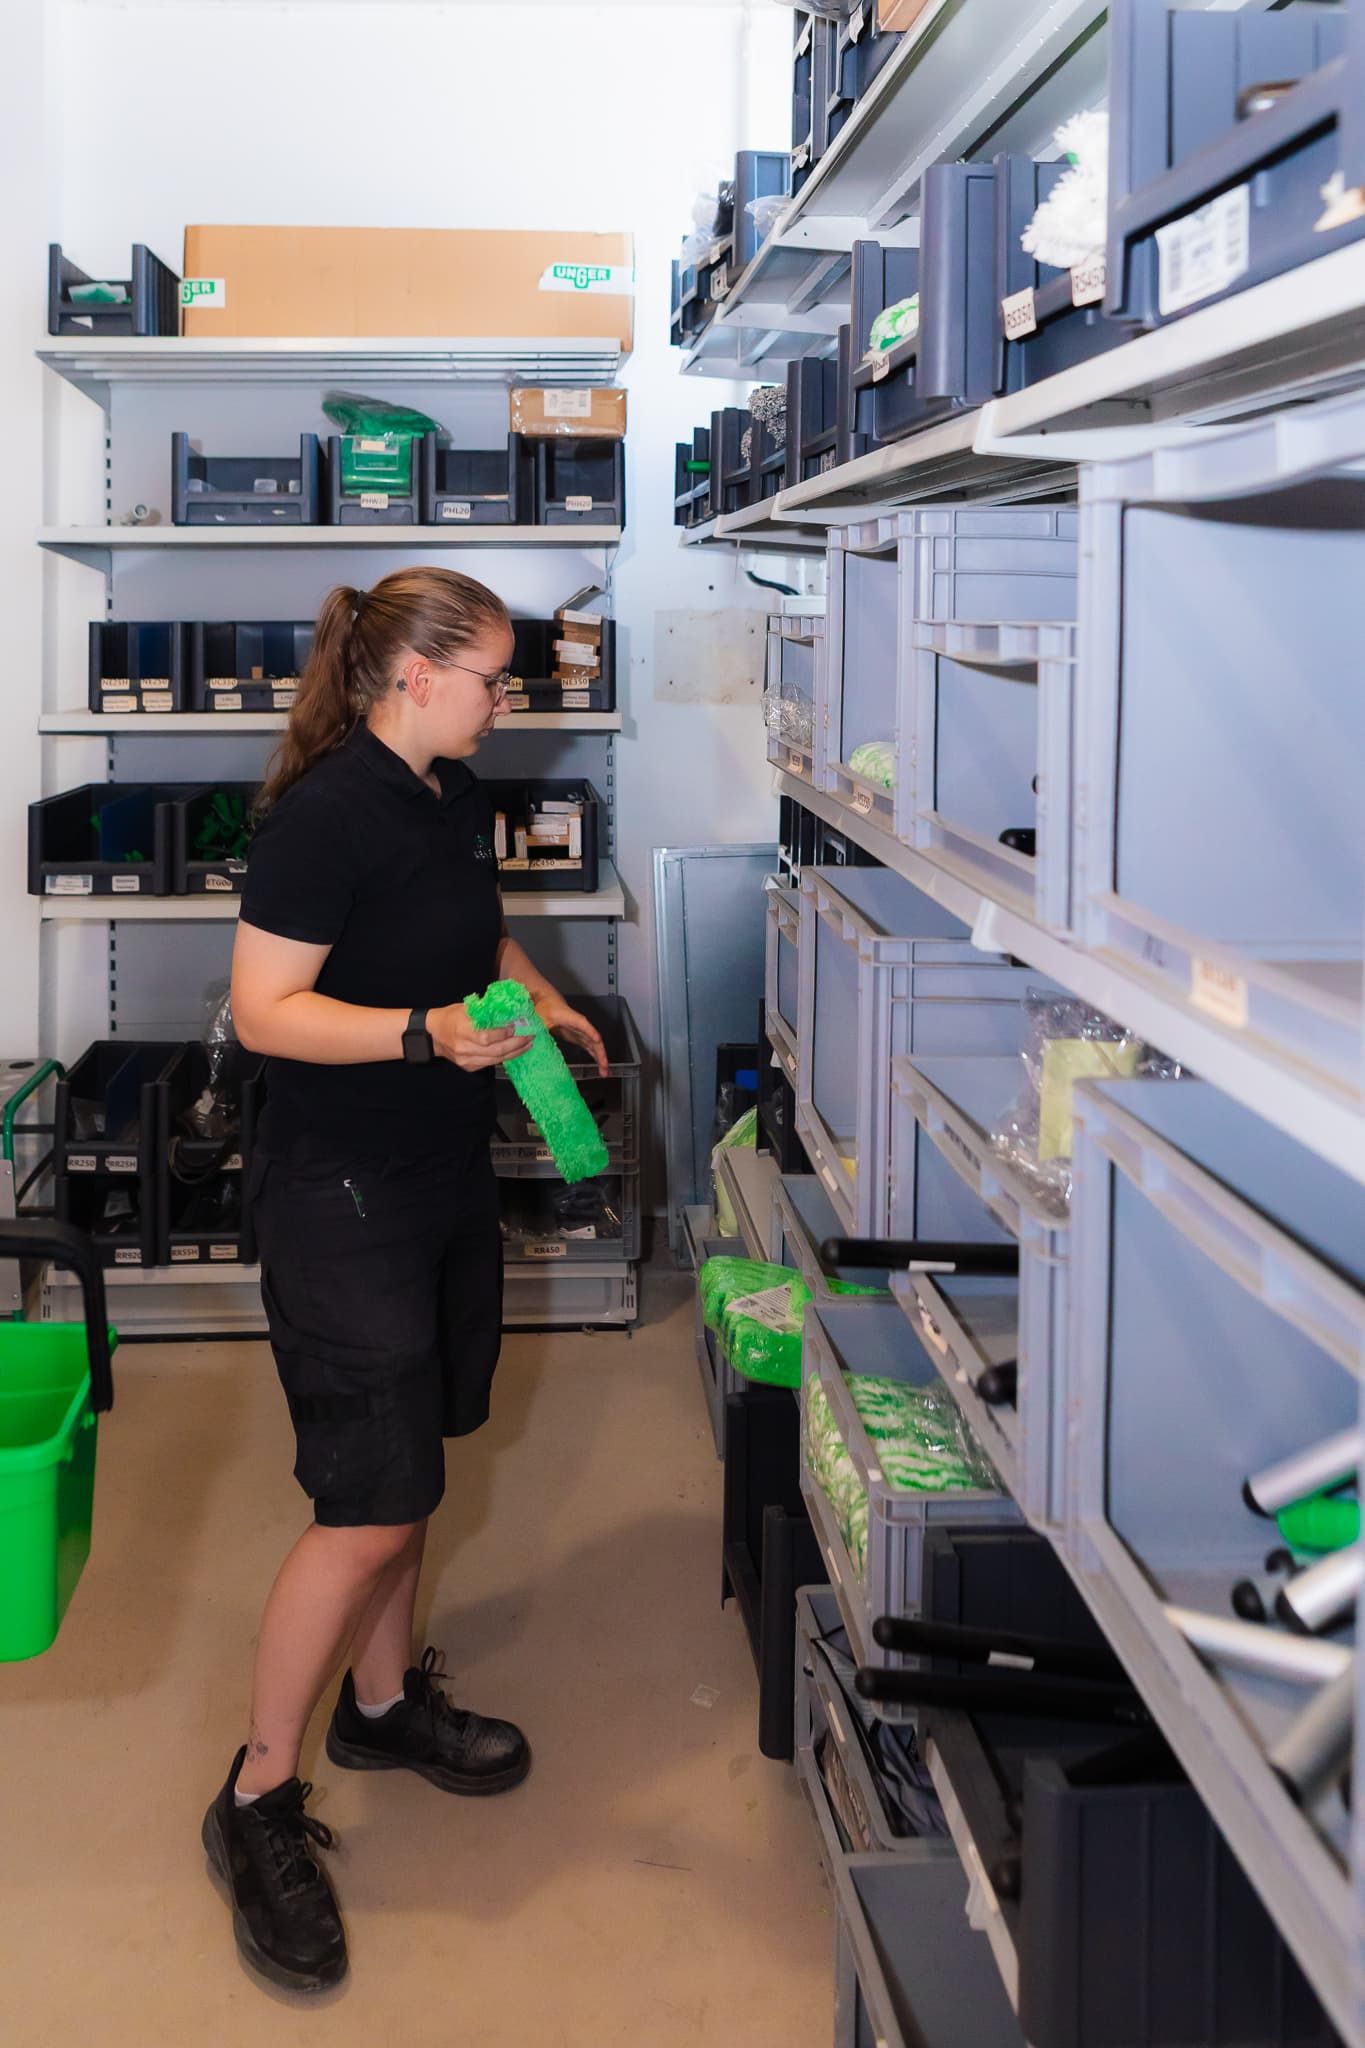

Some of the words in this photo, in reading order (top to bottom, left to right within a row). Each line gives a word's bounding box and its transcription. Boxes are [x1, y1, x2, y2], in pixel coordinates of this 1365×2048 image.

[555, 266, 608, 288] UNGER
[443, 506, 469, 515] PHL20
[69, 1158, 96, 1168] RR250
[110, 1159, 137, 1169] RR25H
[533, 1246, 560, 1254] RR450
